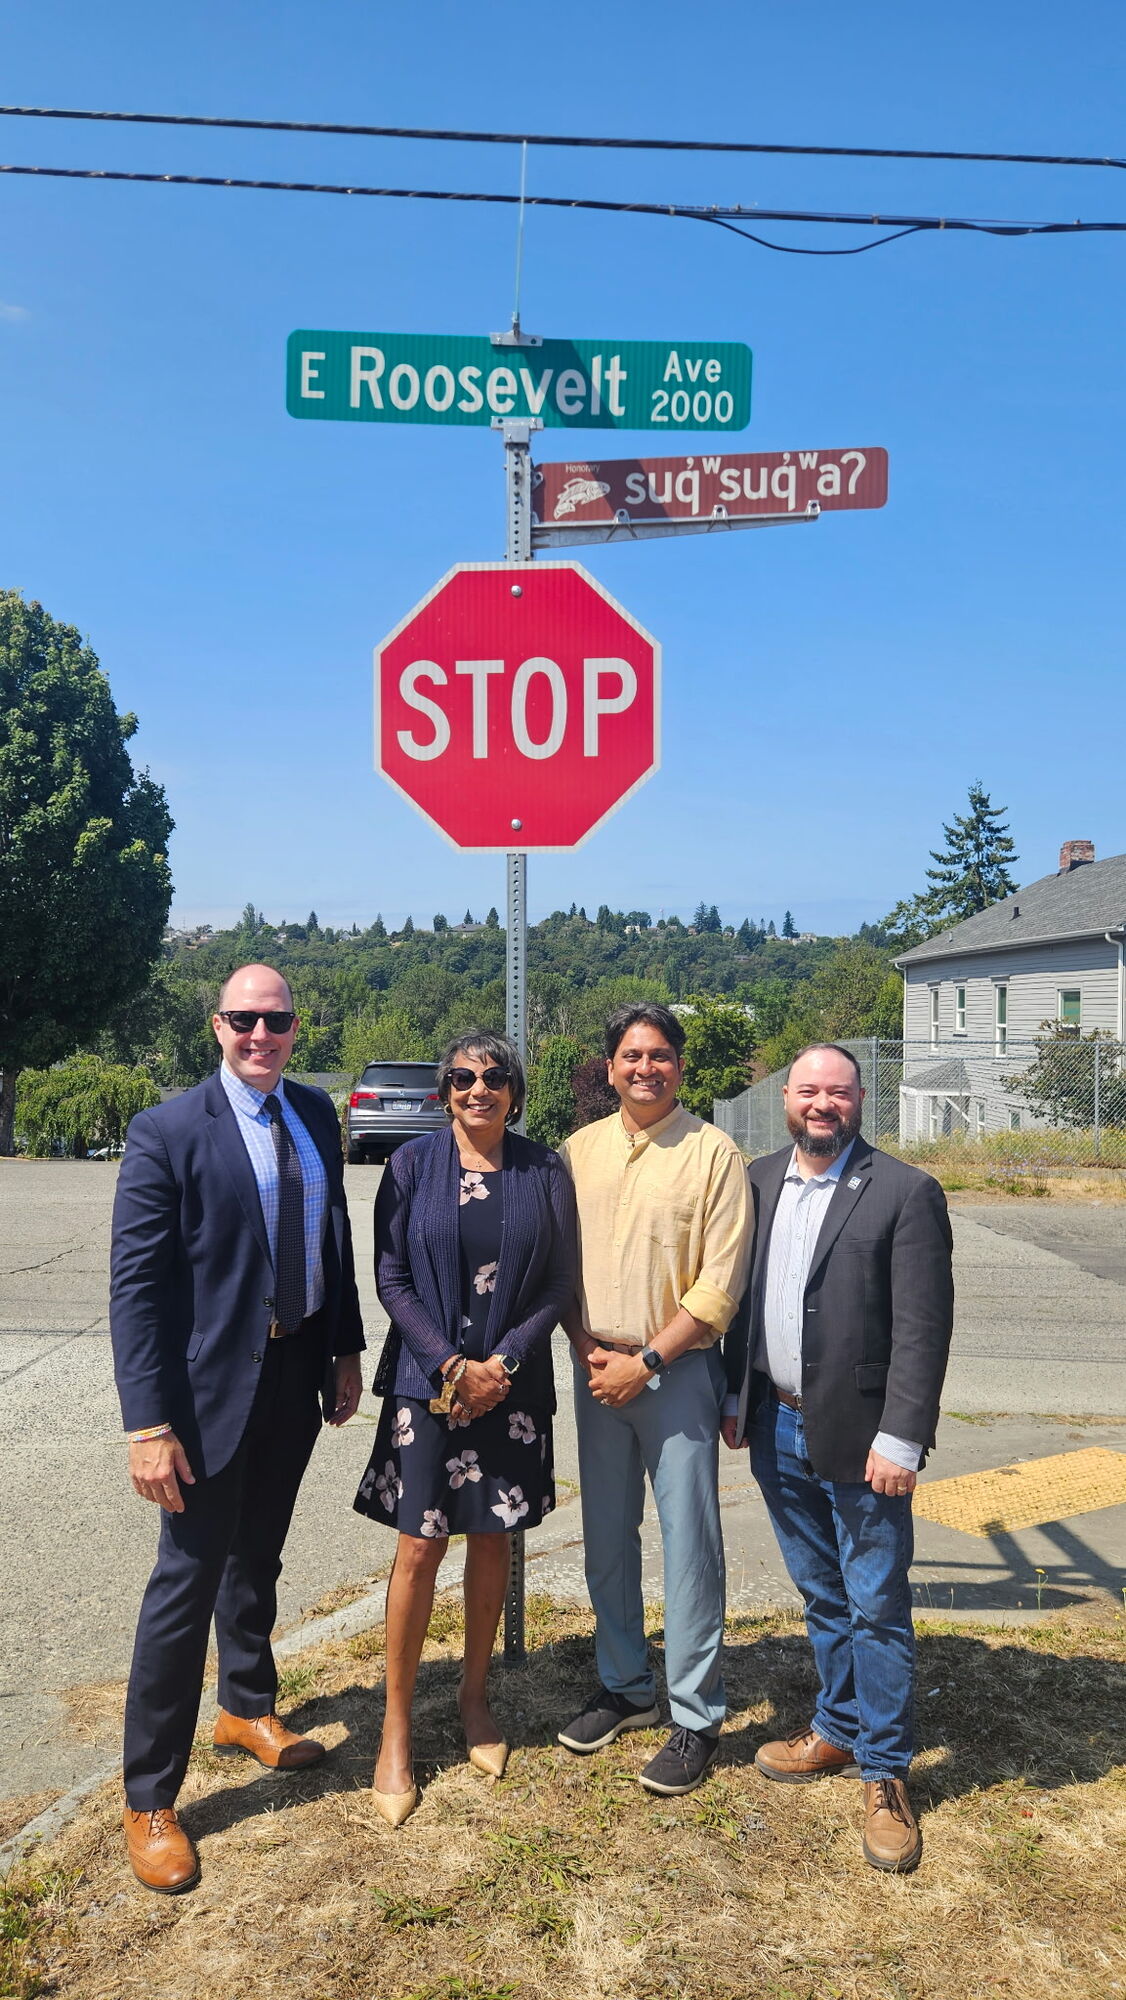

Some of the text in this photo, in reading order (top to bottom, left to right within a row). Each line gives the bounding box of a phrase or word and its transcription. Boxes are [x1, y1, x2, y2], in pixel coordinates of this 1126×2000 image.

[301, 346, 722, 416] E Roosevelt Ave
[650, 389, 735, 423] 2000
[565, 463, 600, 473] Honorary
[396, 656, 638, 761] STOP
